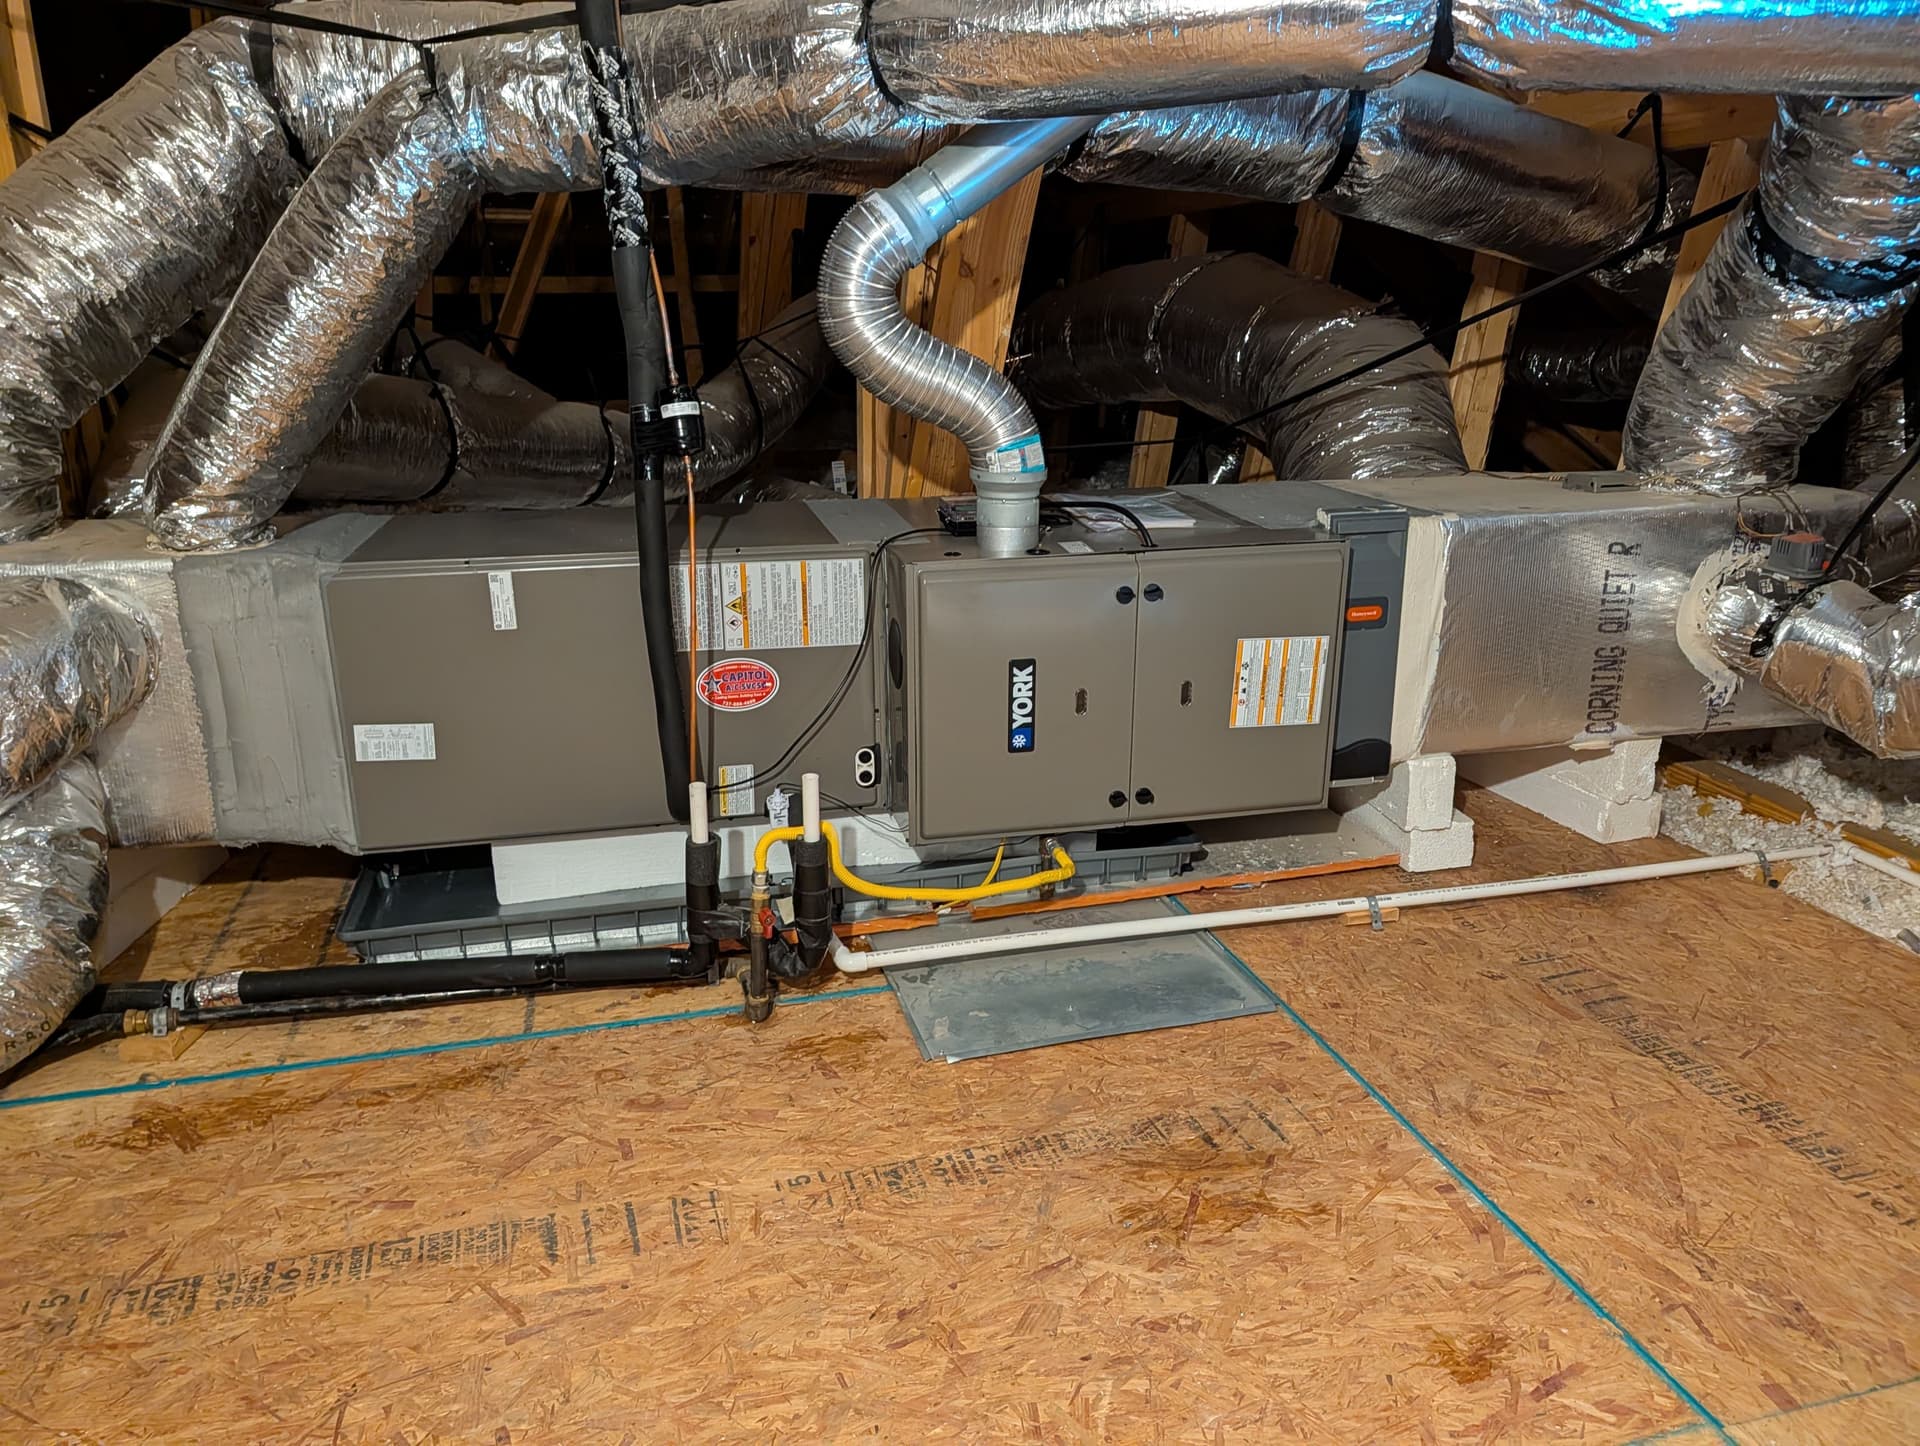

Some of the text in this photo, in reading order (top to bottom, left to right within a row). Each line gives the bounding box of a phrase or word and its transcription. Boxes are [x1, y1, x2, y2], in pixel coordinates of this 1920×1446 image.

[1598, 569, 1637, 634] QUIET
[721, 670, 768, 682] CAPITOL
[1012, 664, 1033, 729] YORK
[1584, 645, 1626, 734] CORNING
